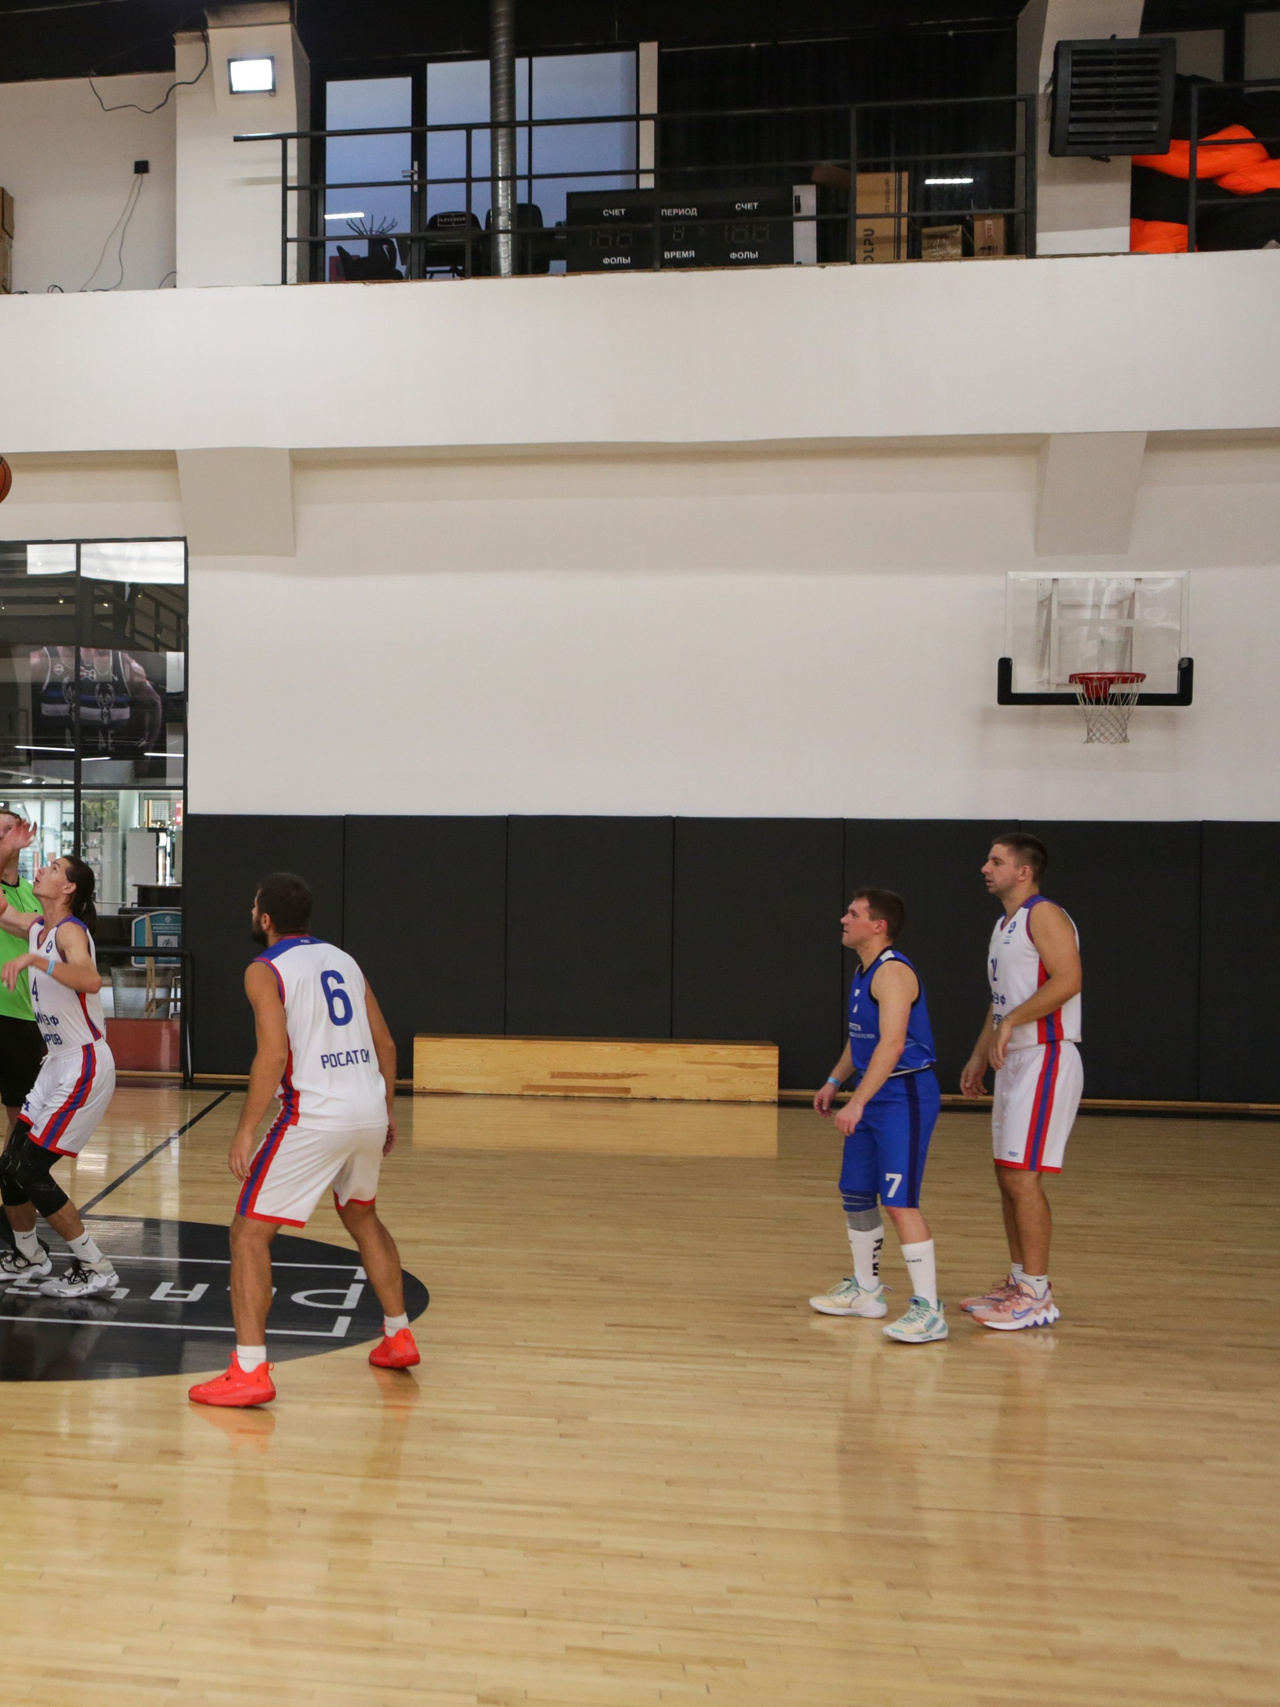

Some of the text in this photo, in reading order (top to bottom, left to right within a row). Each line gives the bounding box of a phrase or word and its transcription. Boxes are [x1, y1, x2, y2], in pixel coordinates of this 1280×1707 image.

[735, 202, 758, 211] СЧЕТ
[602, 208, 626, 217] СЧЕТ
[661, 207, 698, 217] ПЕРИОД
[664, 250, 695, 259] ВРЕМЯ
[730, 251, 758, 259] ФОЛЫ
[602, 256, 631, 265] ФОЛЫ
[321, 969, 354, 1027] 6
[885, 1173, 903, 1198] 7
